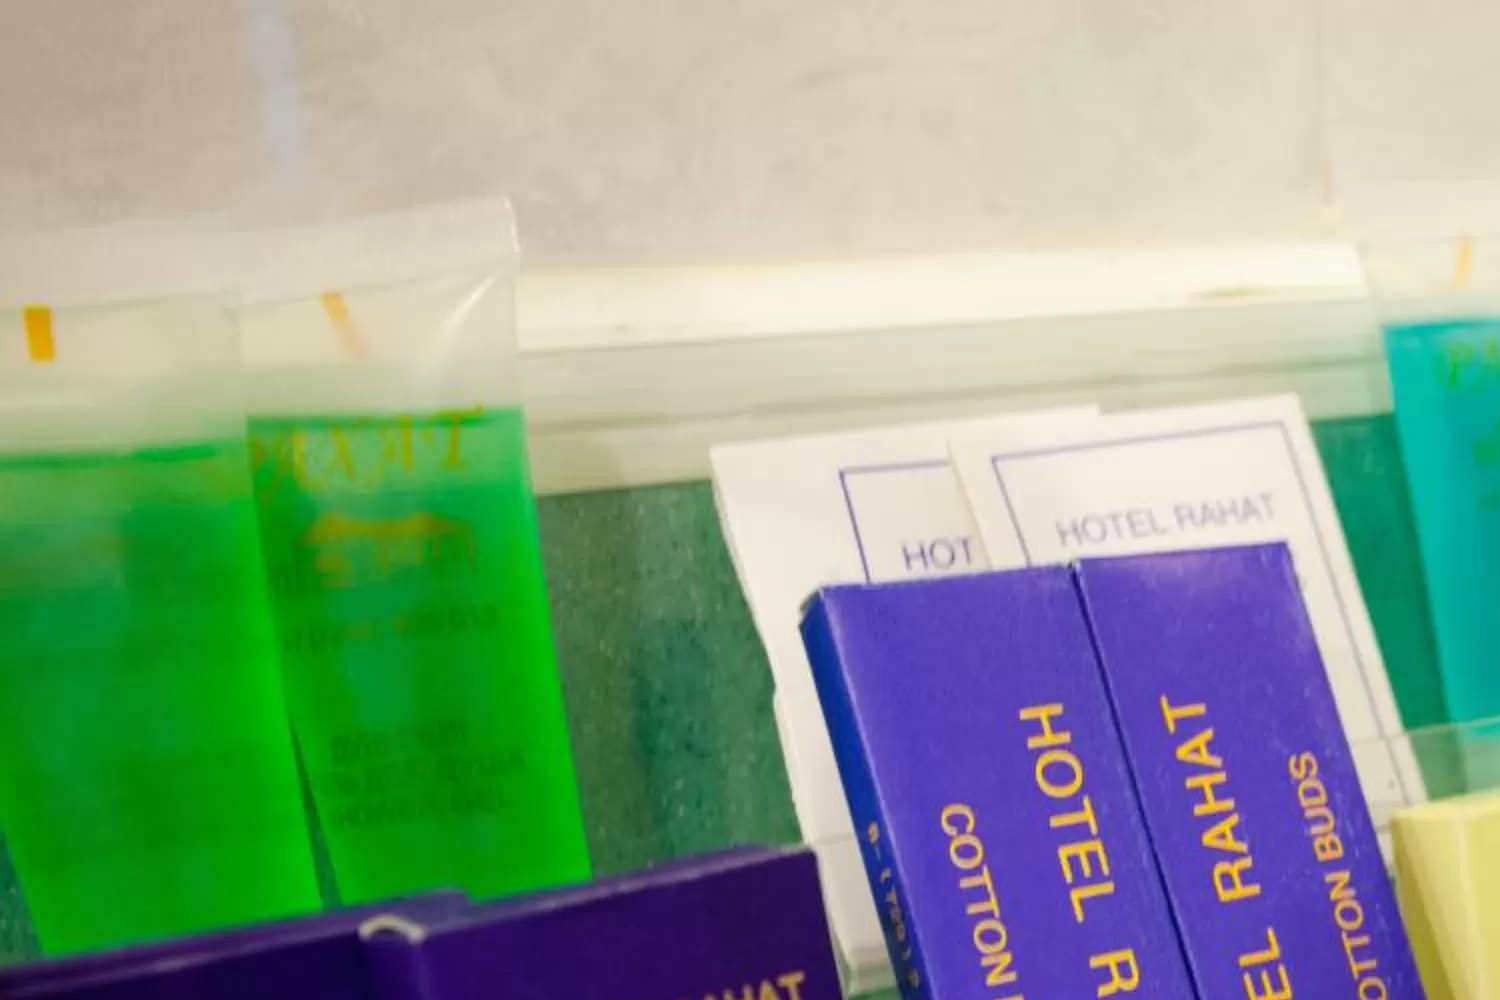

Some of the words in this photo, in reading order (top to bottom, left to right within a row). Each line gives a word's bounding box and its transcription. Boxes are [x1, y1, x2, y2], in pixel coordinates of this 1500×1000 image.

[900, 536, 975, 571] HOT
[1055, 507, 1168, 547] HOTEL
[1174, 492, 1276, 531] RAHAT
[1018, 702, 1116, 924] HOTEL
[1159, 694, 1262, 903] RAHAT
[1287, 750, 1345, 863] BUDS
[940, 803, 1018, 987] COTTON
